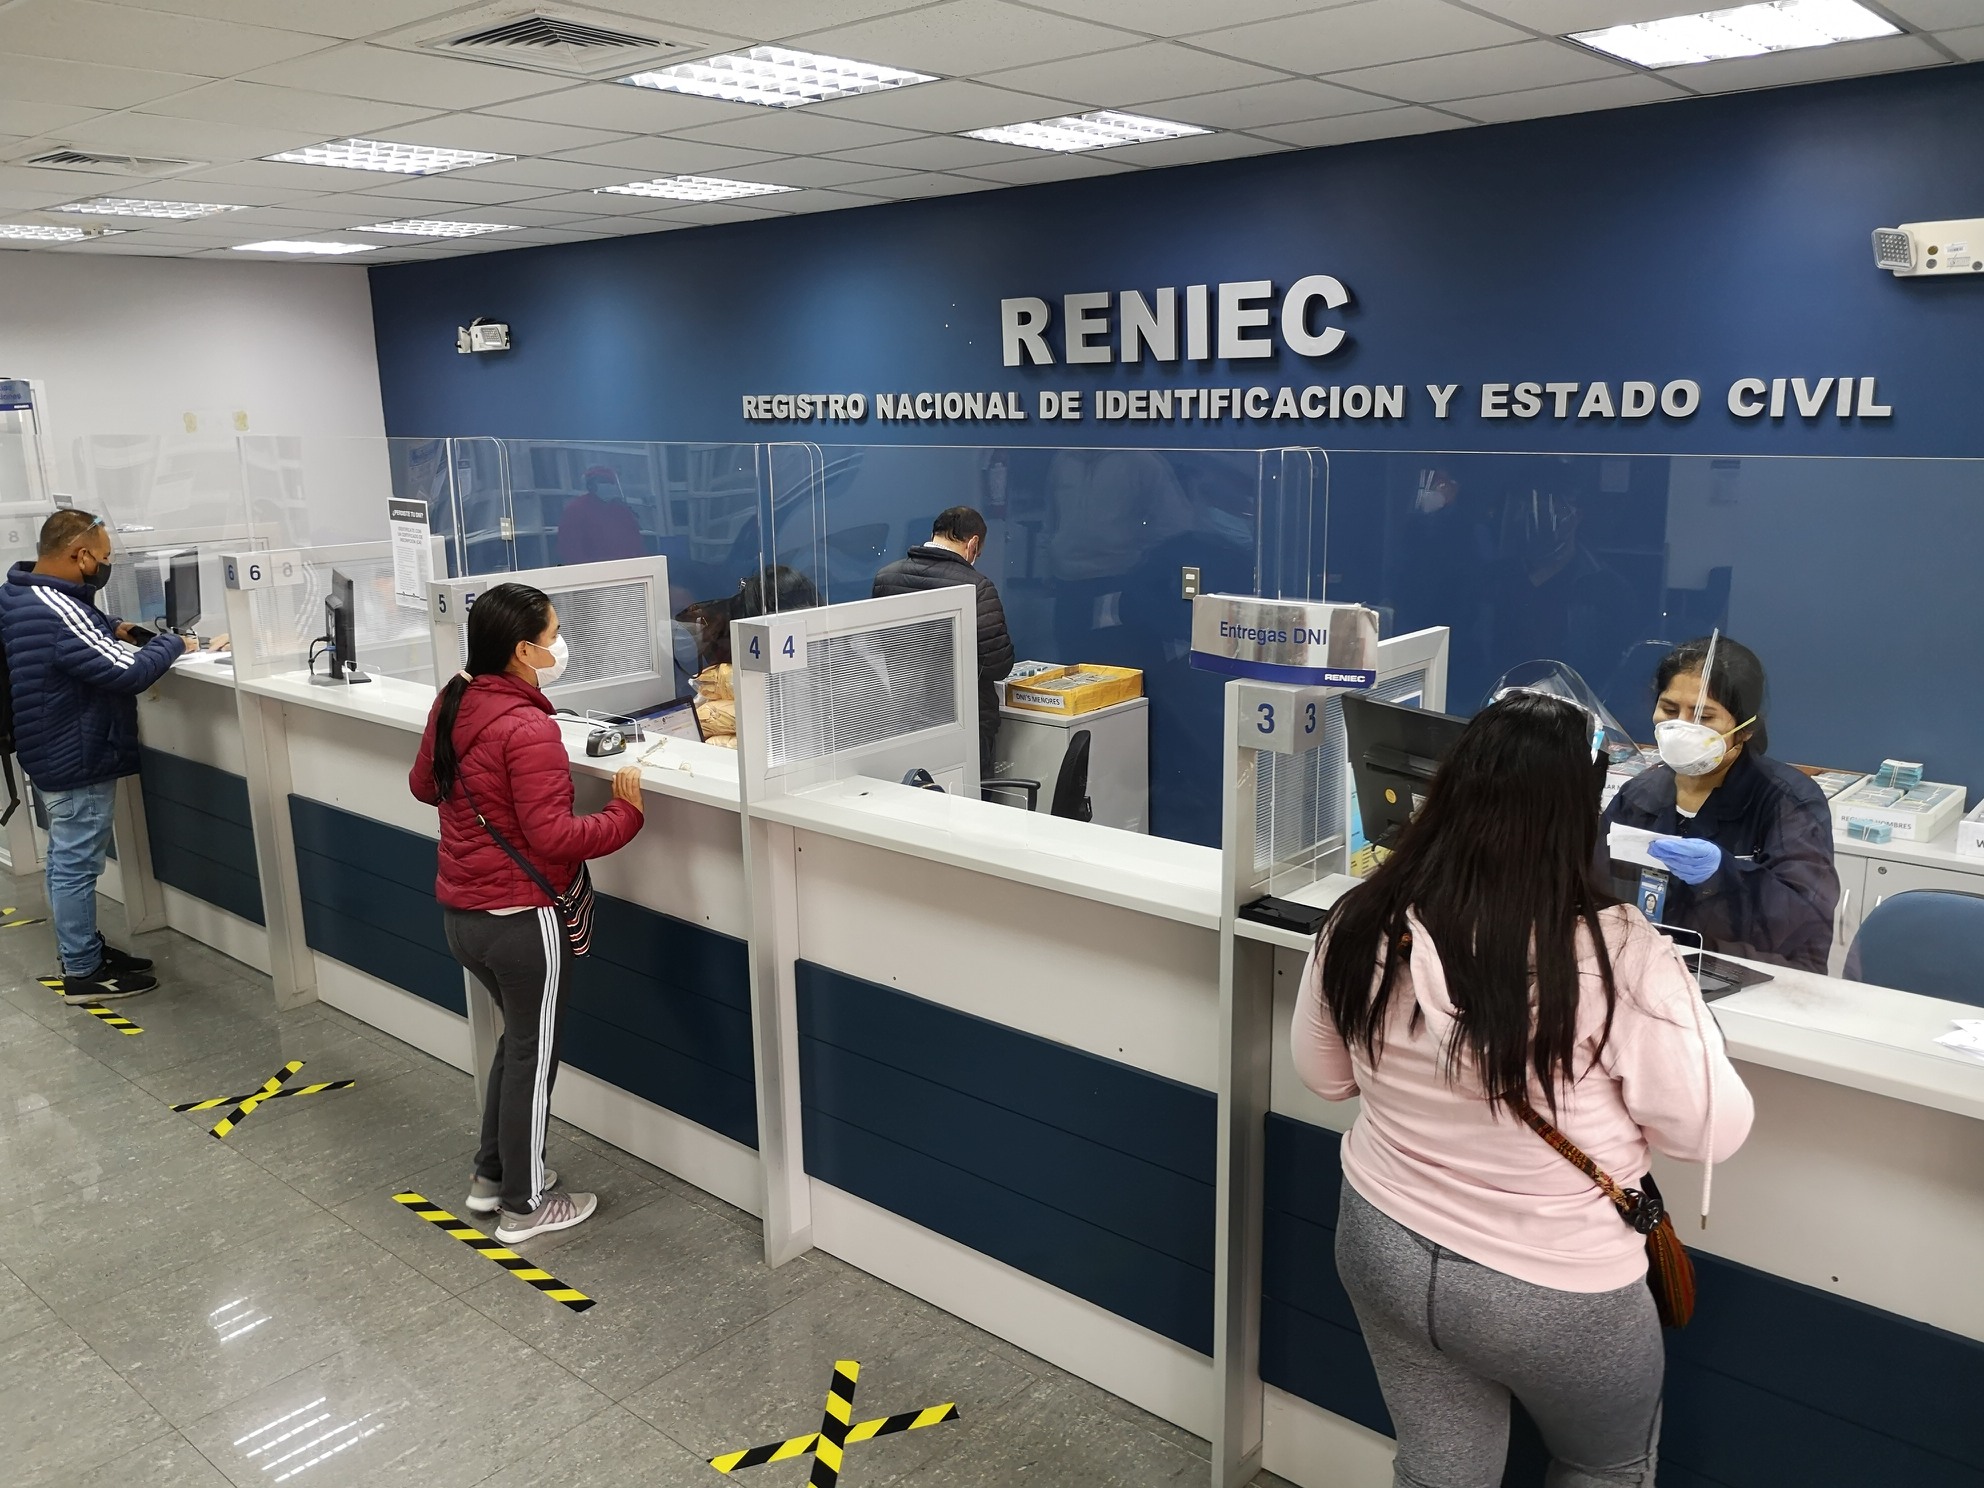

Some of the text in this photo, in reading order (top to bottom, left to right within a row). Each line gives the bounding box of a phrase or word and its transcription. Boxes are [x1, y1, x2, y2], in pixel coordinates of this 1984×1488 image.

[1001, 275, 1349, 367] RENIEC
[742, 376, 1892, 420] REGISTRO NACIONAL DE IDENTIFICACION Y ESTADO CIVIL
[228, 564, 235, 581] 6
[249, 564, 262, 581] 6
[438, 593, 447, 614] 5
[1220, 621, 1327, 646] Entregas DNI
[749, 635, 761, 660] 4
[782, 635, 796, 659] 4
[1324, 673, 1366, 683] RENIEC
[1031, 696, 1061, 706] MENORES
[1256, 702, 1275, 734] 3
[1304, 702, 1317, 734] 3
